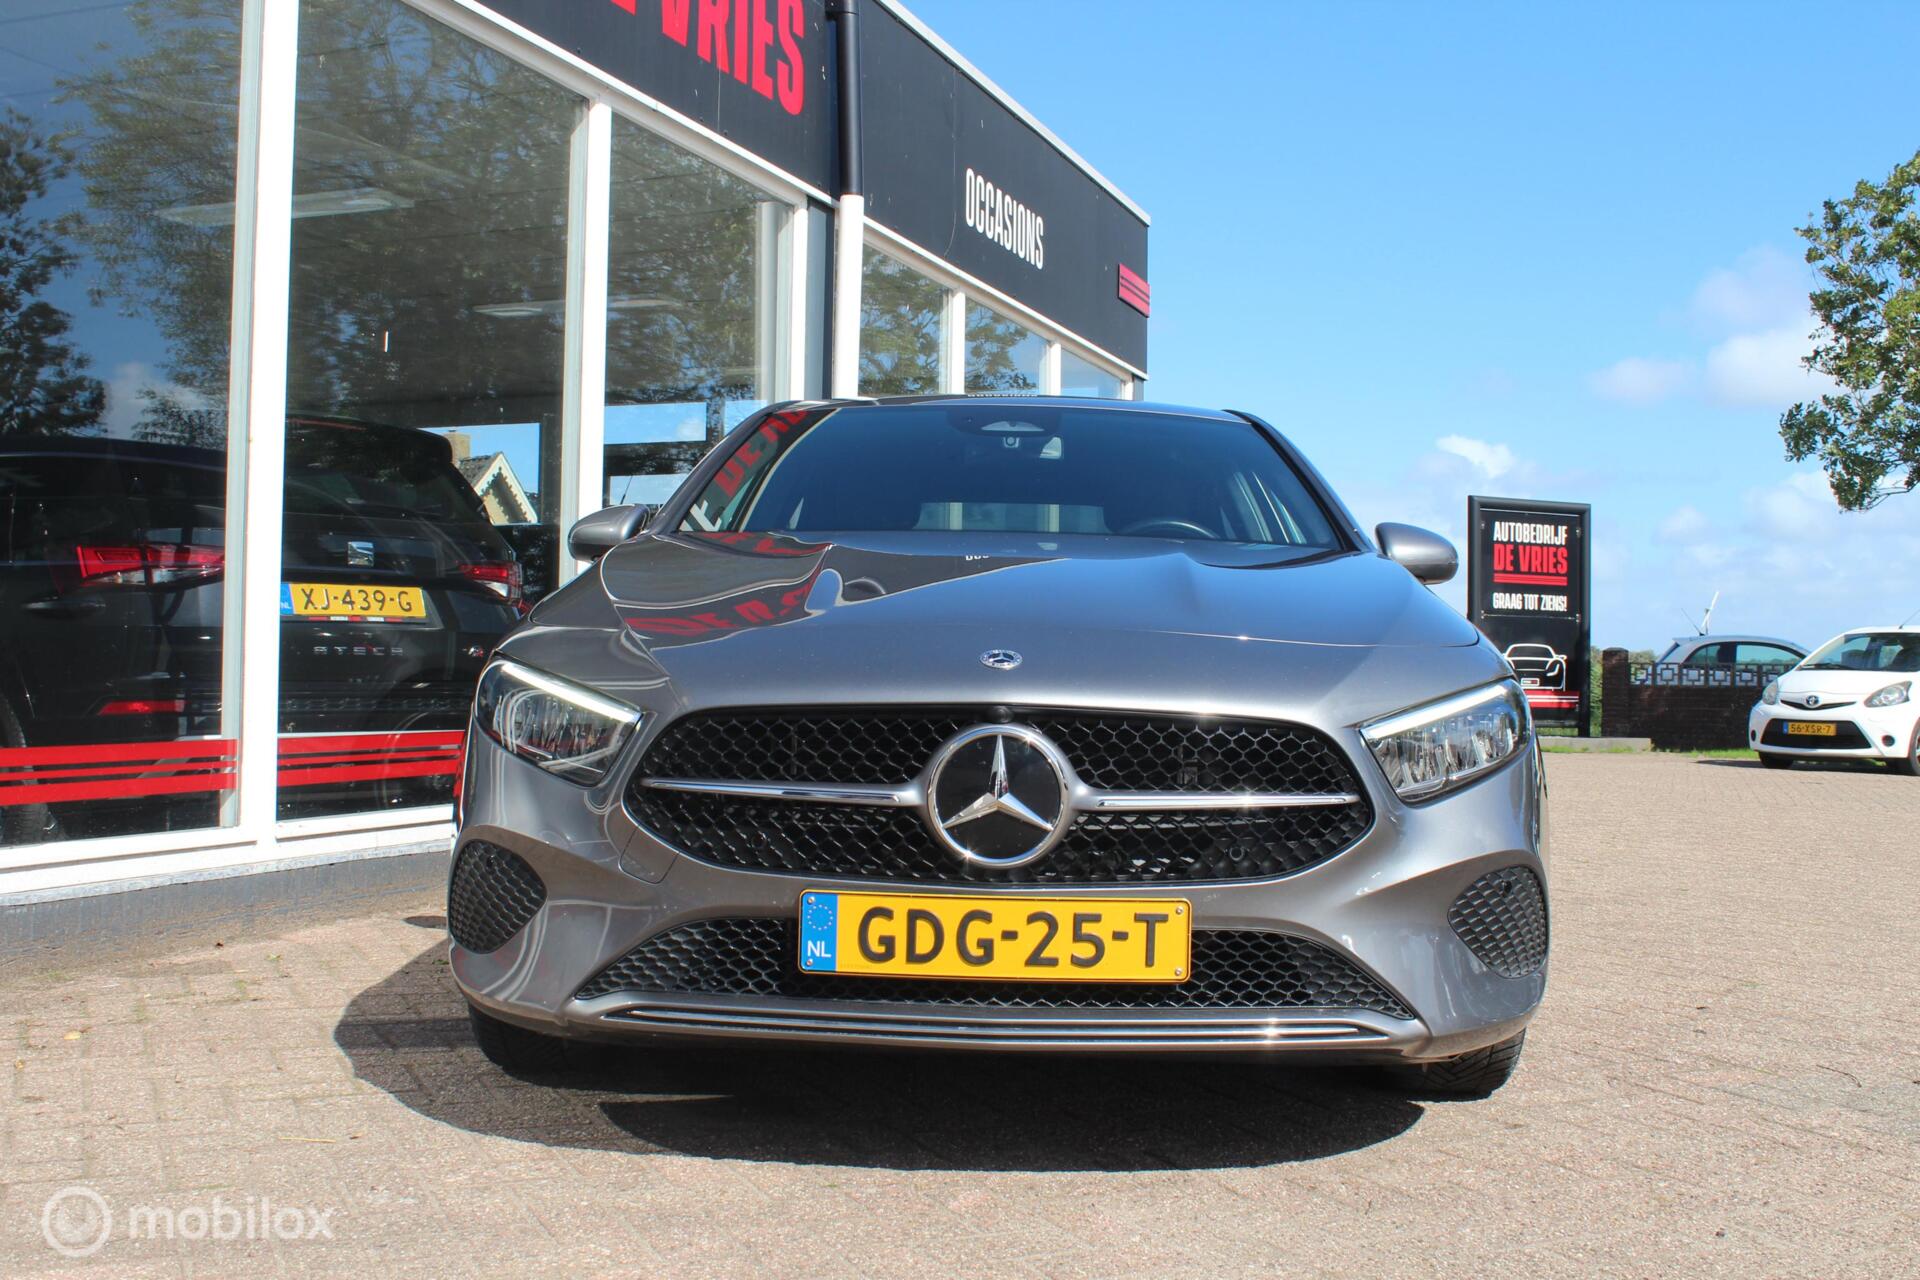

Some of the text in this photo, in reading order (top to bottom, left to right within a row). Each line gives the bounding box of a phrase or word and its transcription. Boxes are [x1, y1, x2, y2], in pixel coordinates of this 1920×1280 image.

[965, 167, 1044, 270] OCCASIONS
[1493, 521, 1568, 546] AUTOBEDRIJF
[1493, 543, 1568, 574] DE VRIES
[301, 587, 413, 613] XJ-439-G
[1492, 592, 1568, 612] GRAAG TOT ZIENS!
[1790, 723, 1832, 734] 56-XSR-7
[807, 906, 1169, 968] NL GDG-25-T
